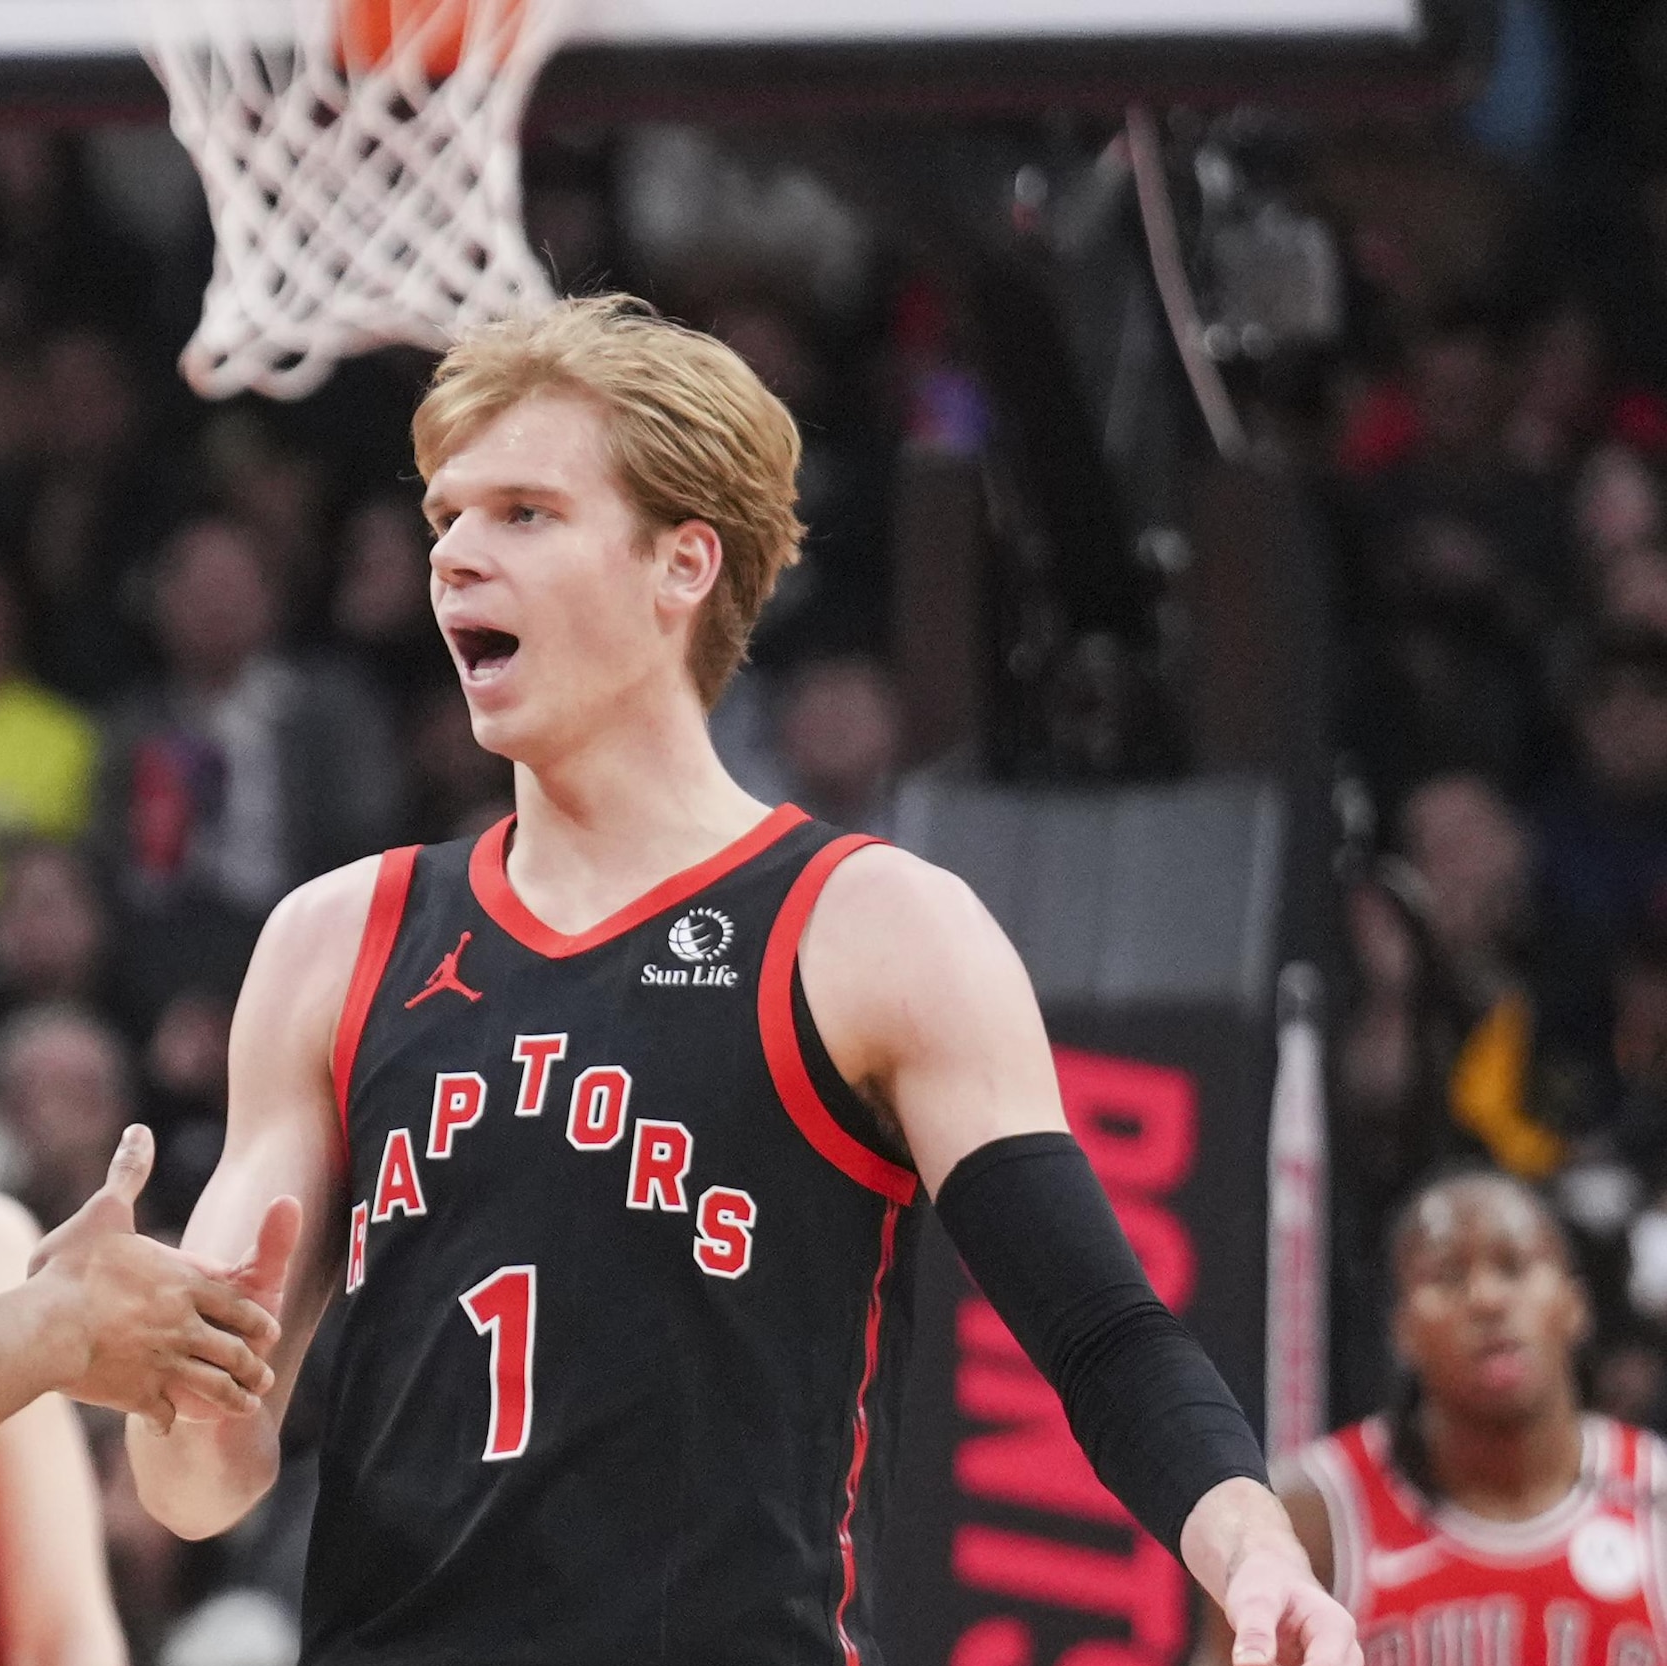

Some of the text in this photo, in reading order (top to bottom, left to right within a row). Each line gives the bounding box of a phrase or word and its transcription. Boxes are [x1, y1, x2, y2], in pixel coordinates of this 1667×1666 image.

[641, 963, 738, 987] Sun Life
[345, 1033, 756, 1294] RAPTORS
[459, 1264, 536, 1461] 1
